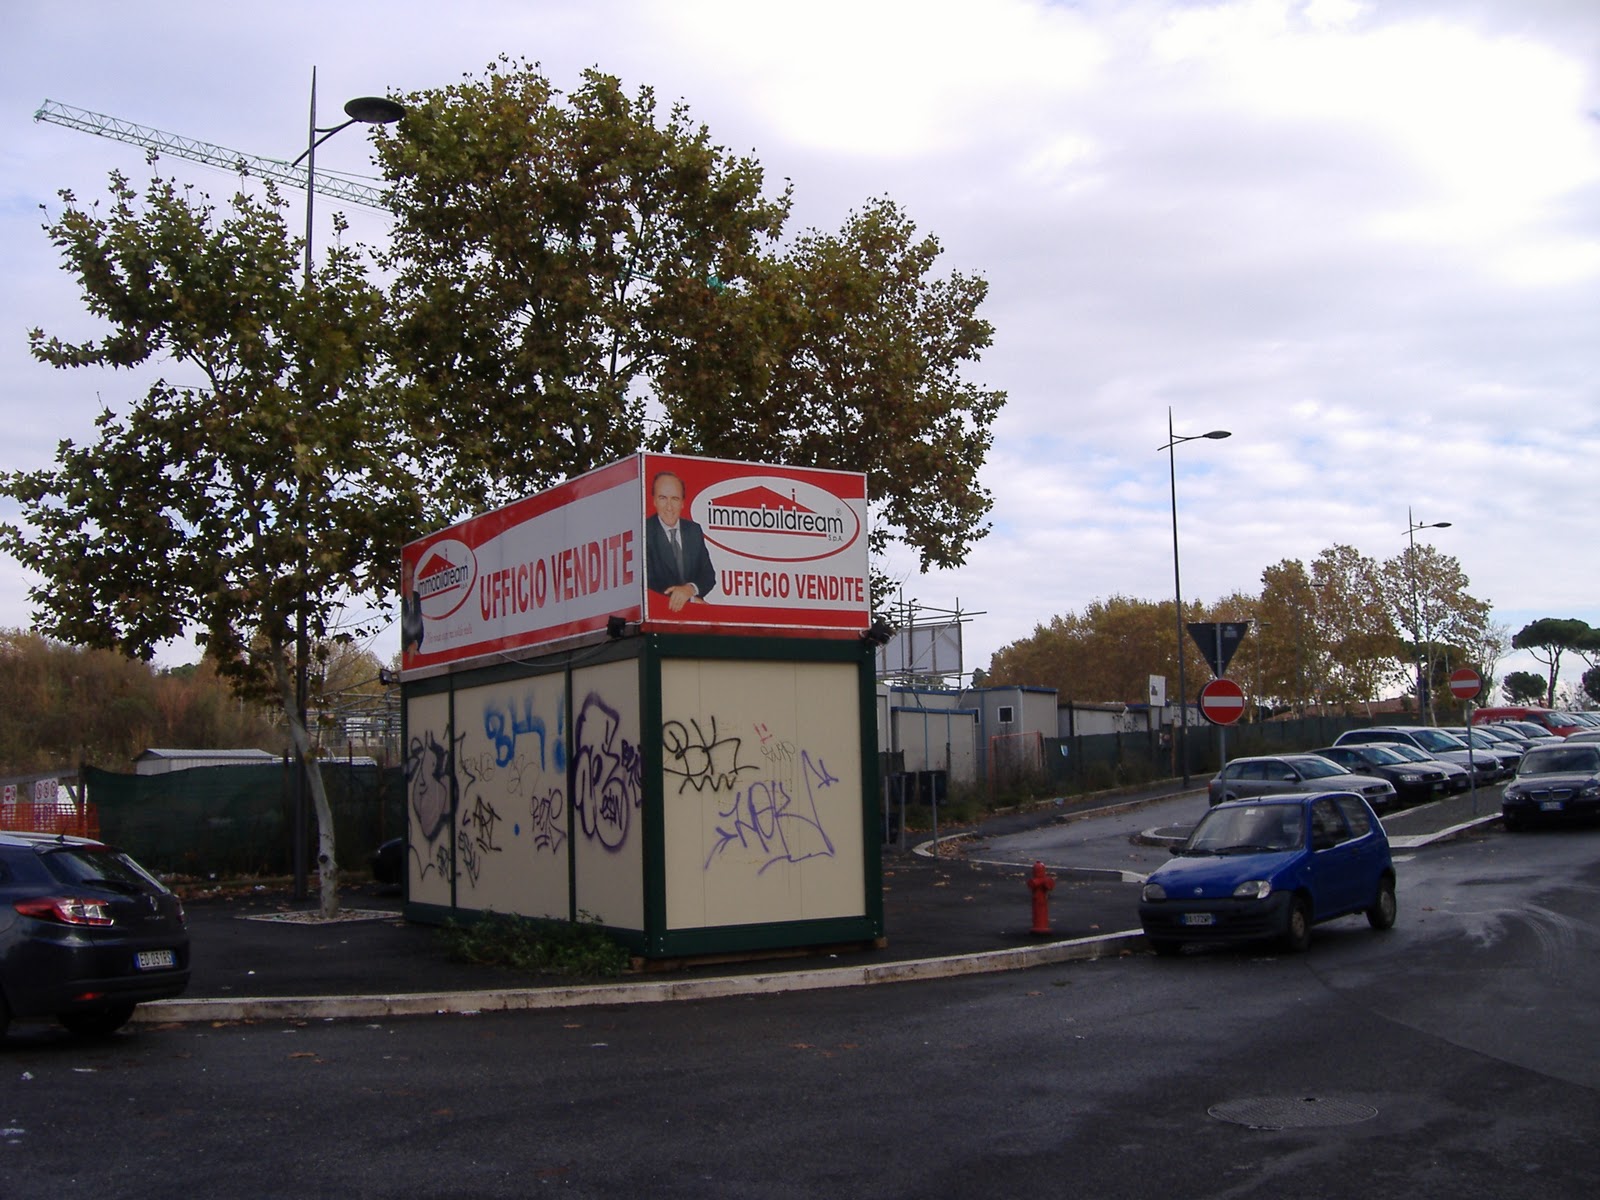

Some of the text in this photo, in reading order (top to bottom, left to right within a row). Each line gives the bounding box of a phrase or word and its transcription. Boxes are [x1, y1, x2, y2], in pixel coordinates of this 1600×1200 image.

[707, 499, 844, 534] immobildream
[480, 529, 633, 622] UFFICIO VENDITE
[721, 570, 865, 603] UFFICIO VENDITE
